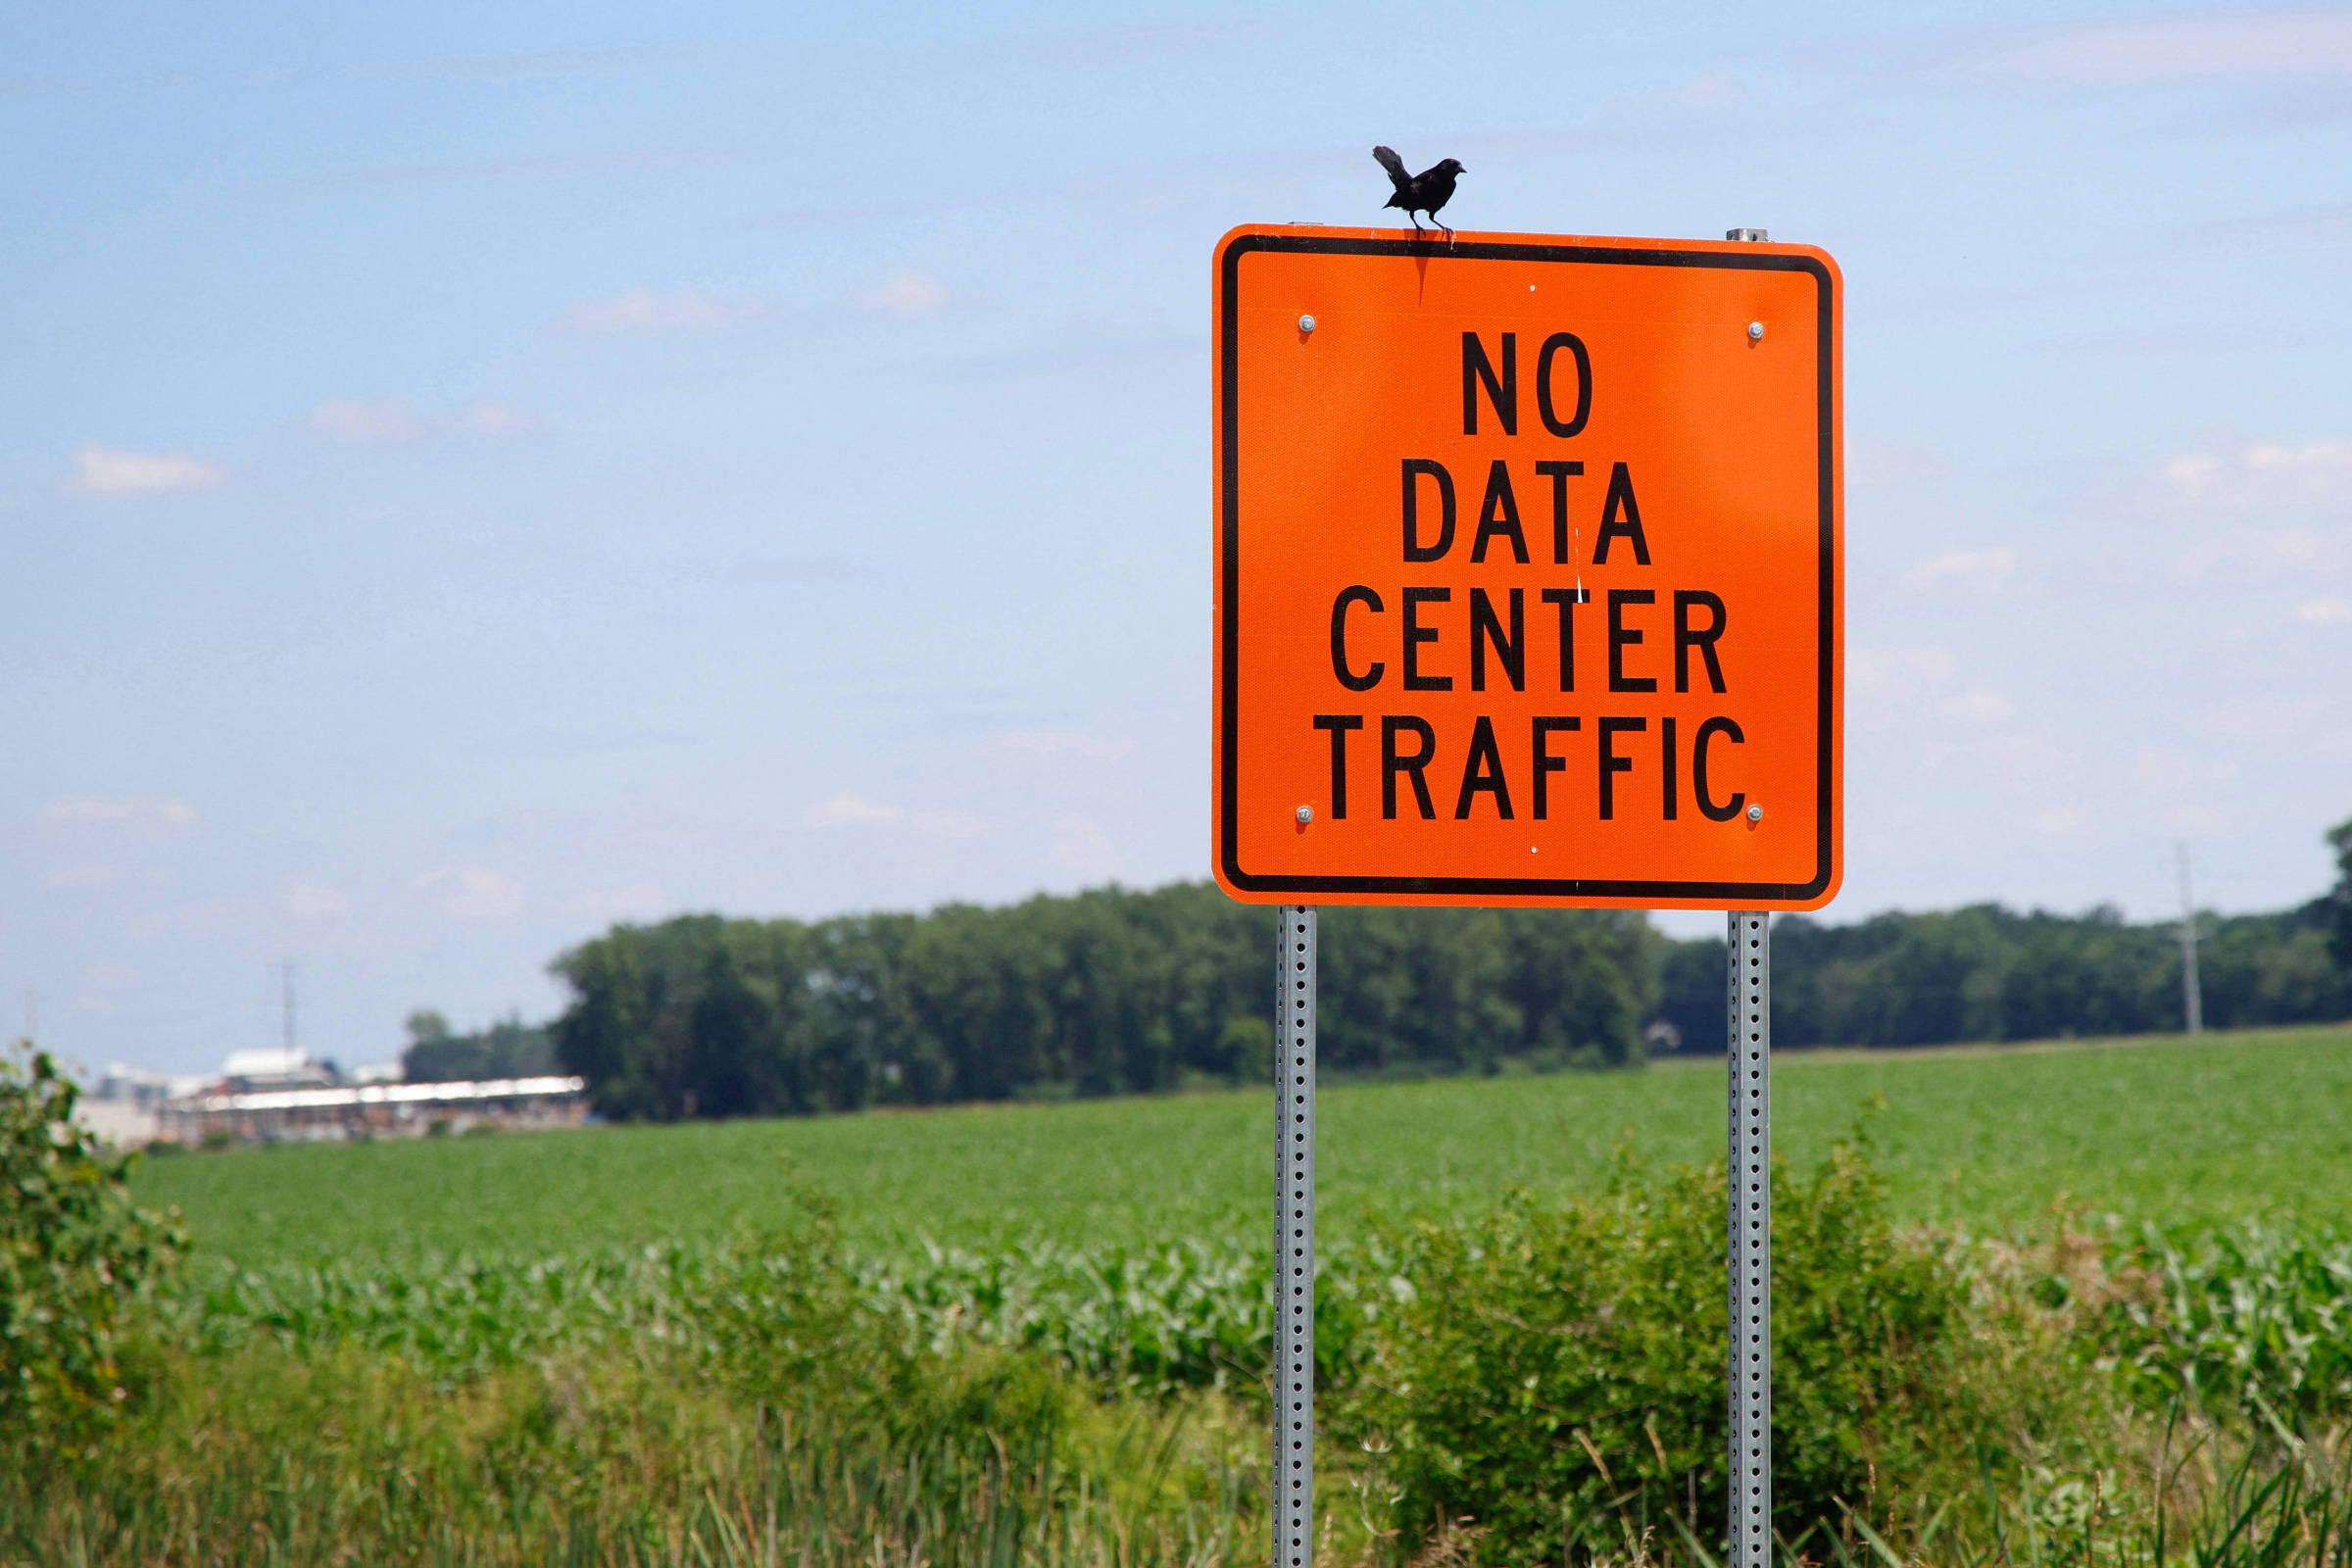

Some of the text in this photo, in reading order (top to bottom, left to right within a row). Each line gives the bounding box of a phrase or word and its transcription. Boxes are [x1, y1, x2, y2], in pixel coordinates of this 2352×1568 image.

[1463, 331, 1592, 437] NO
[1401, 459, 1652, 565] DATA
[1330, 584, 1728, 693] CENTER
[1312, 714, 1745, 822] TRAFFIC
